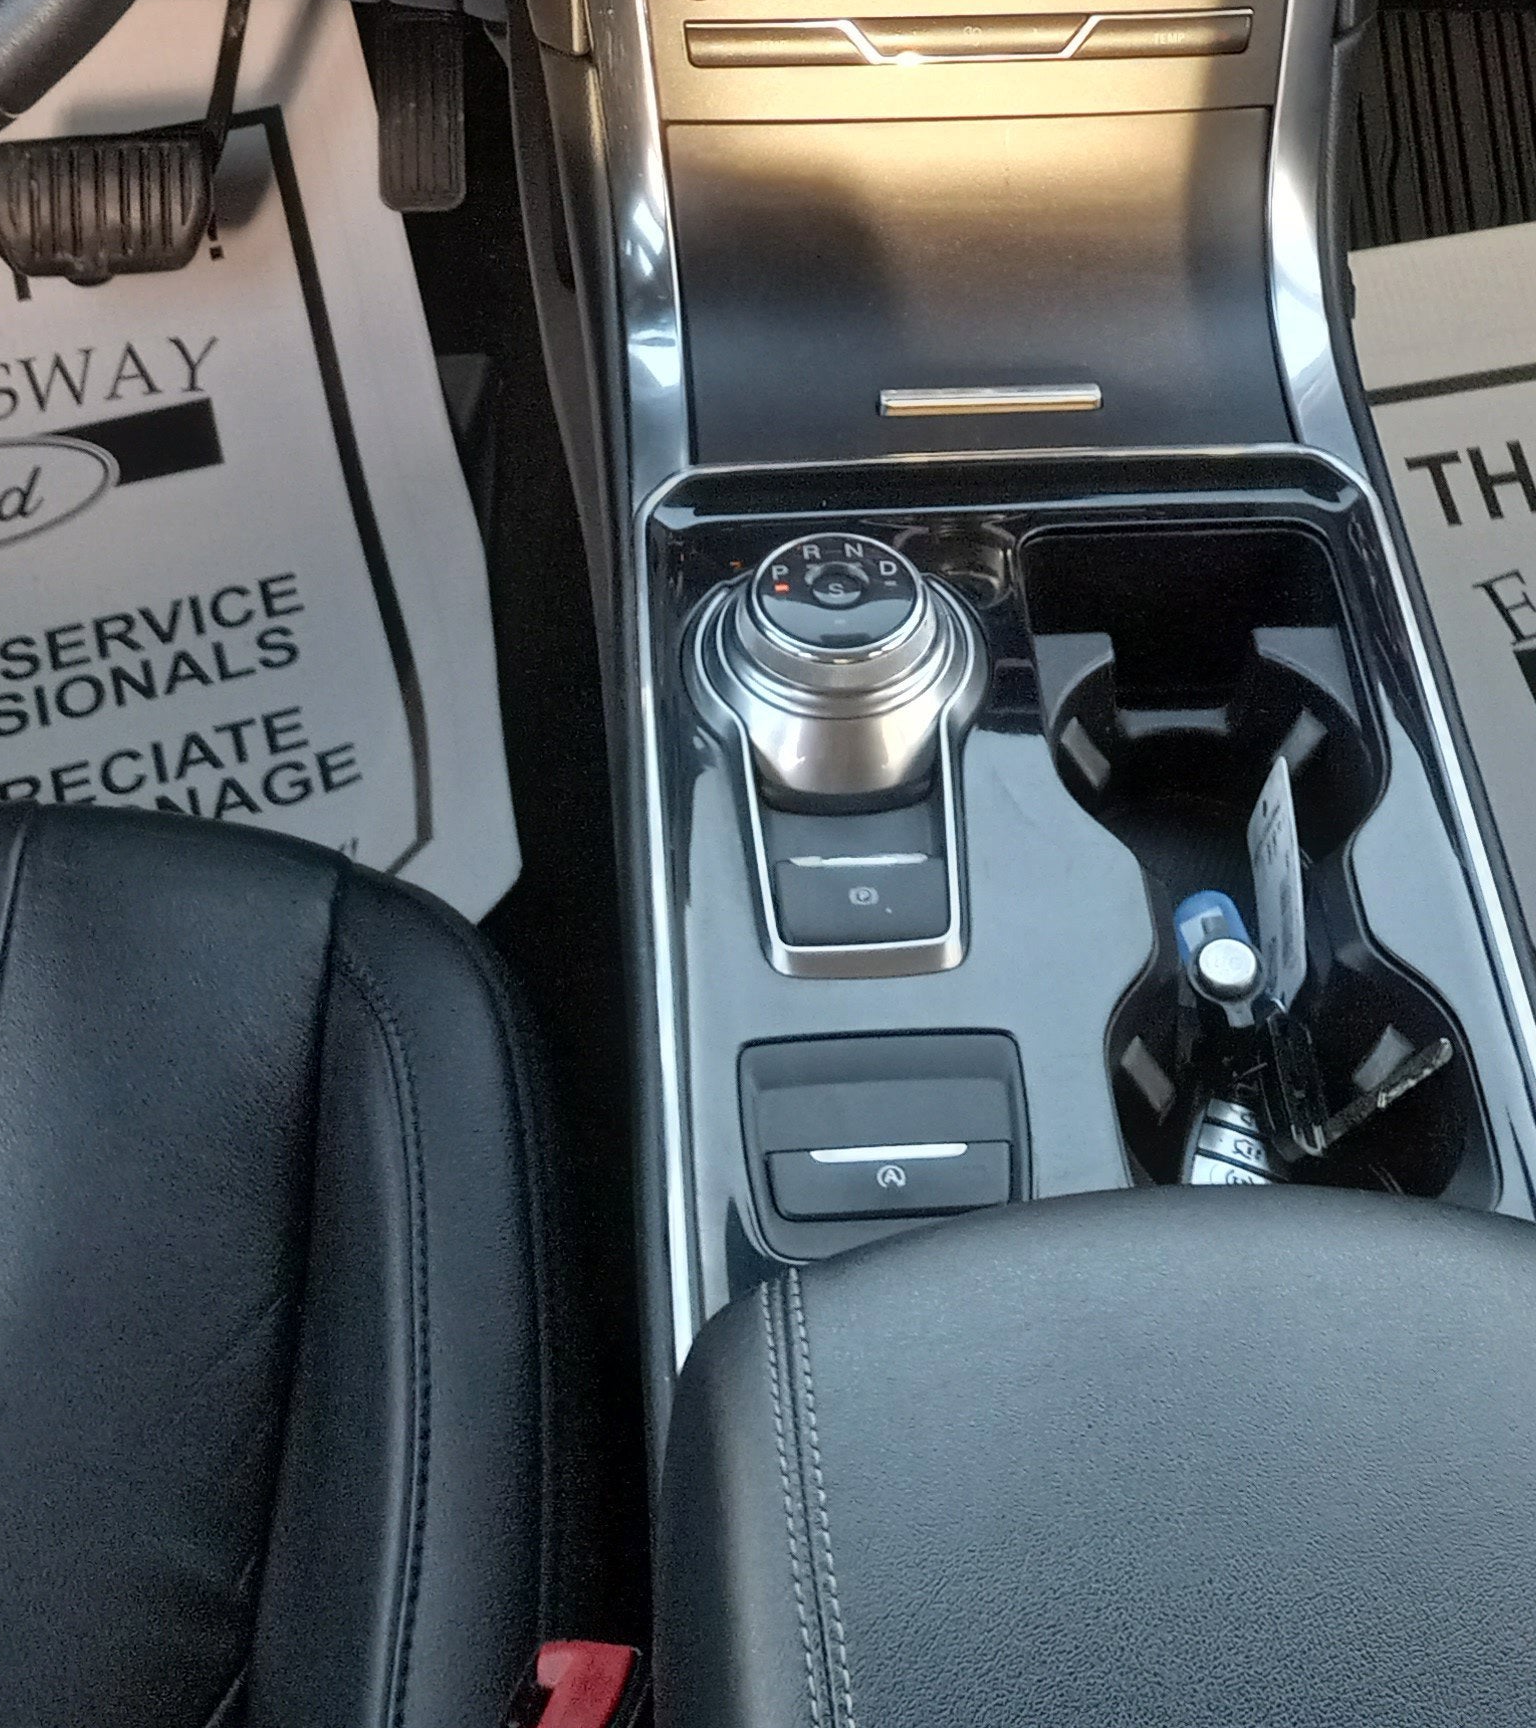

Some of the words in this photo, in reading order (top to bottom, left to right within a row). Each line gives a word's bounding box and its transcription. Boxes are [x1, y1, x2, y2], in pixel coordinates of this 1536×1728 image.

[802, 544, 822, 560] R
[844, 542, 864, 558] N
[771, 564, 789, 580] P
[879, 560, 897, 576] D
[828, 582, 844, 598] S
